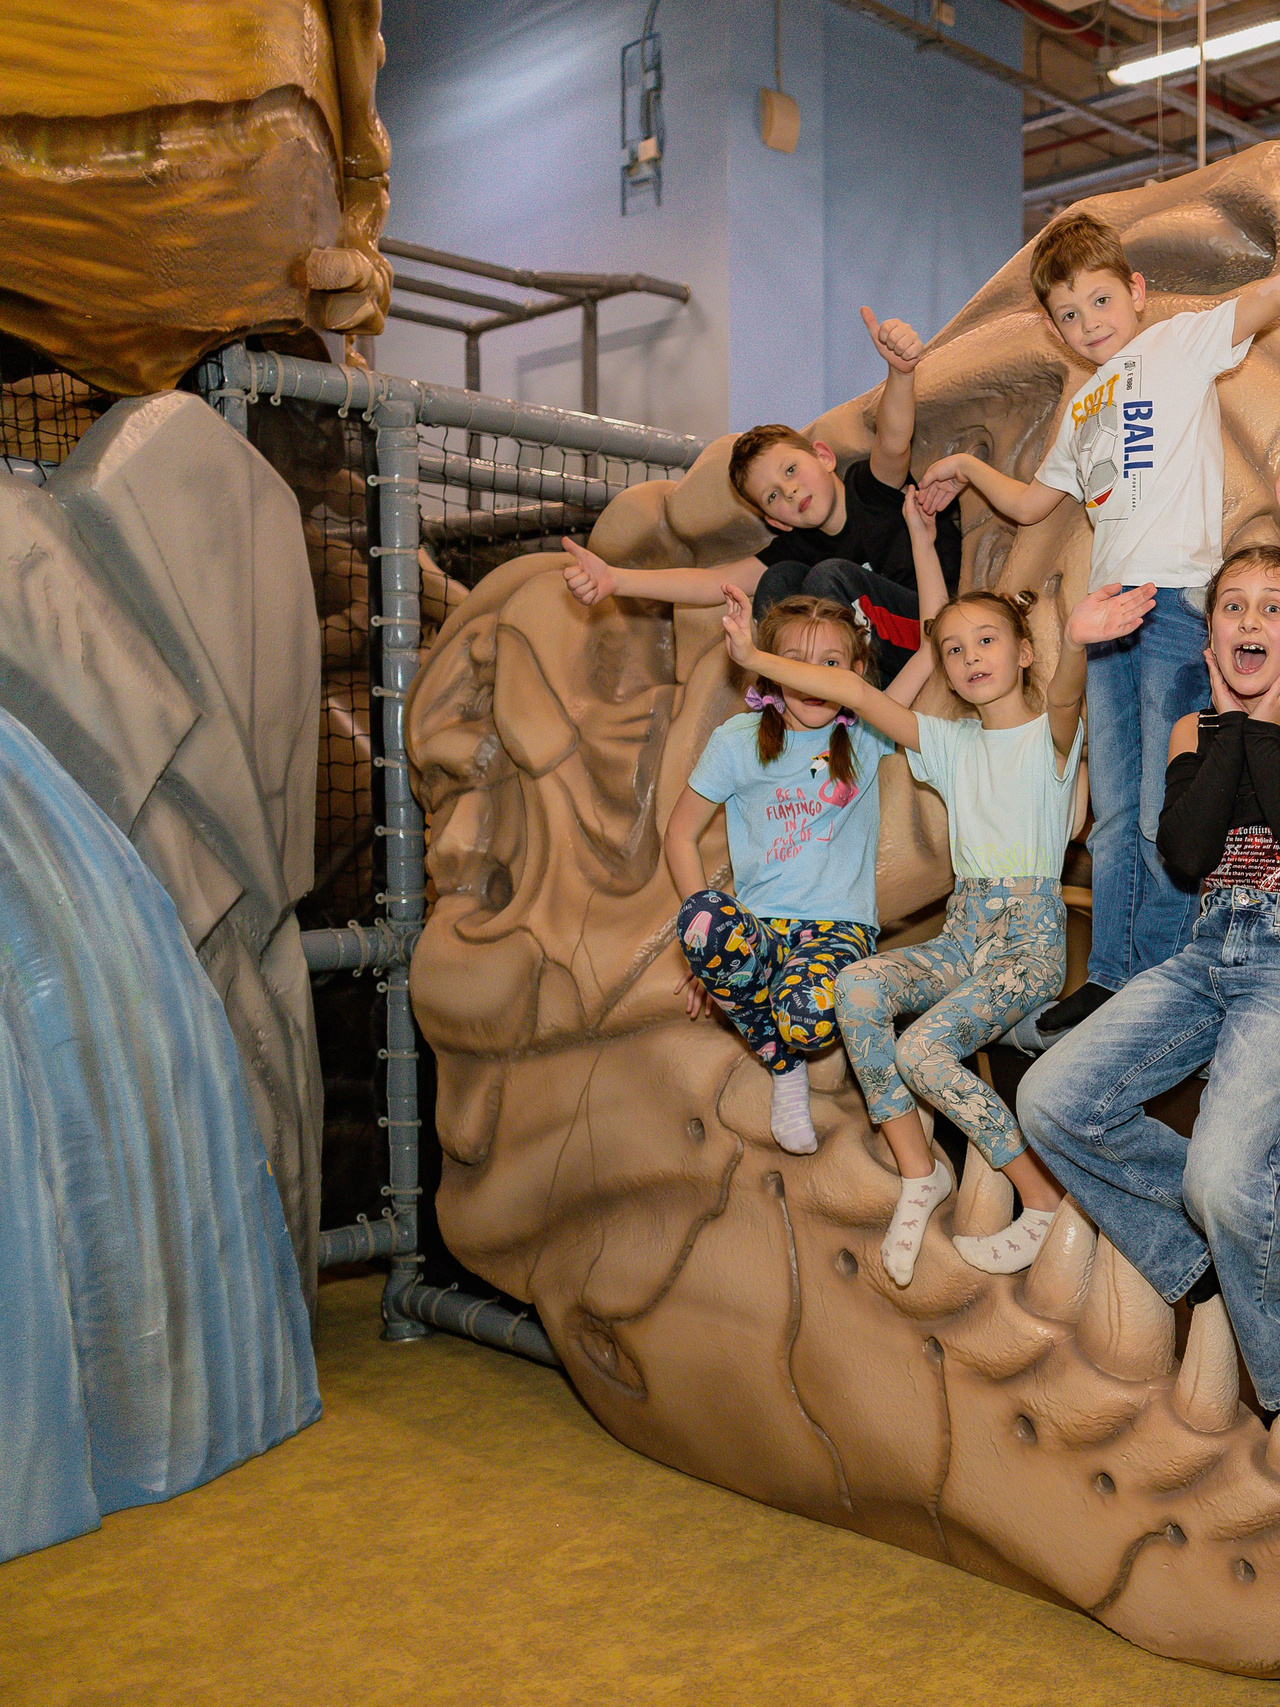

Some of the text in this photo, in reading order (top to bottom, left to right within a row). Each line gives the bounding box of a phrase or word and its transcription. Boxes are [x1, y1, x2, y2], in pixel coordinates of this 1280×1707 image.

[1123, 400, 1154, 479] BALL
[775, 787, 806, 803] BE A
[766, 799, 822, 821] FLAMINGO
